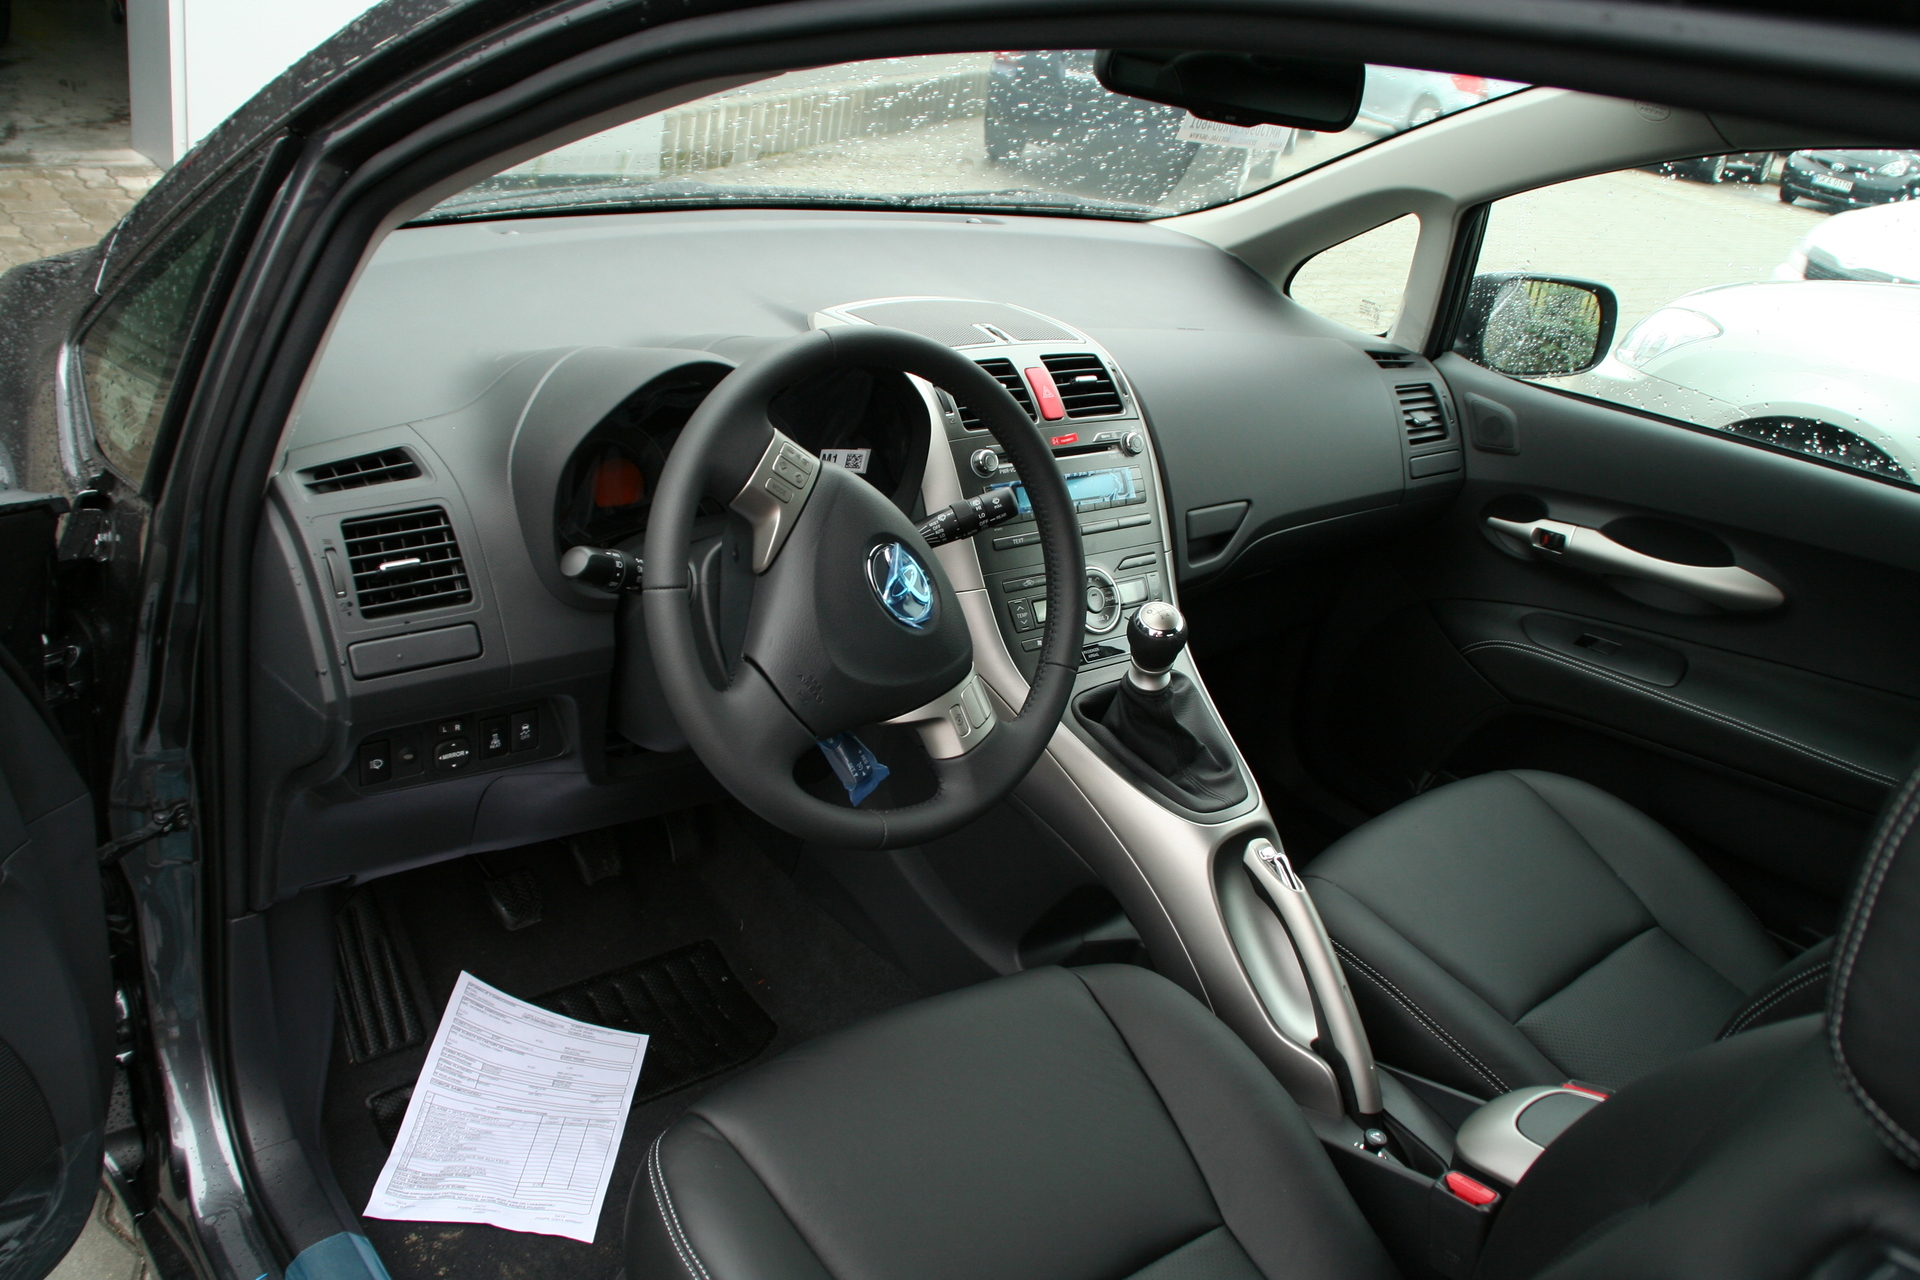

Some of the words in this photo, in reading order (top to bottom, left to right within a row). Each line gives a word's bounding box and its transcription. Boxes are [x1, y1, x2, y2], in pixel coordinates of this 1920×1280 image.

[822, 453, 838, 463] M1
[1012, 537, 1024, 545] TEXT
[442, 750, 465, 760] MIRROR
